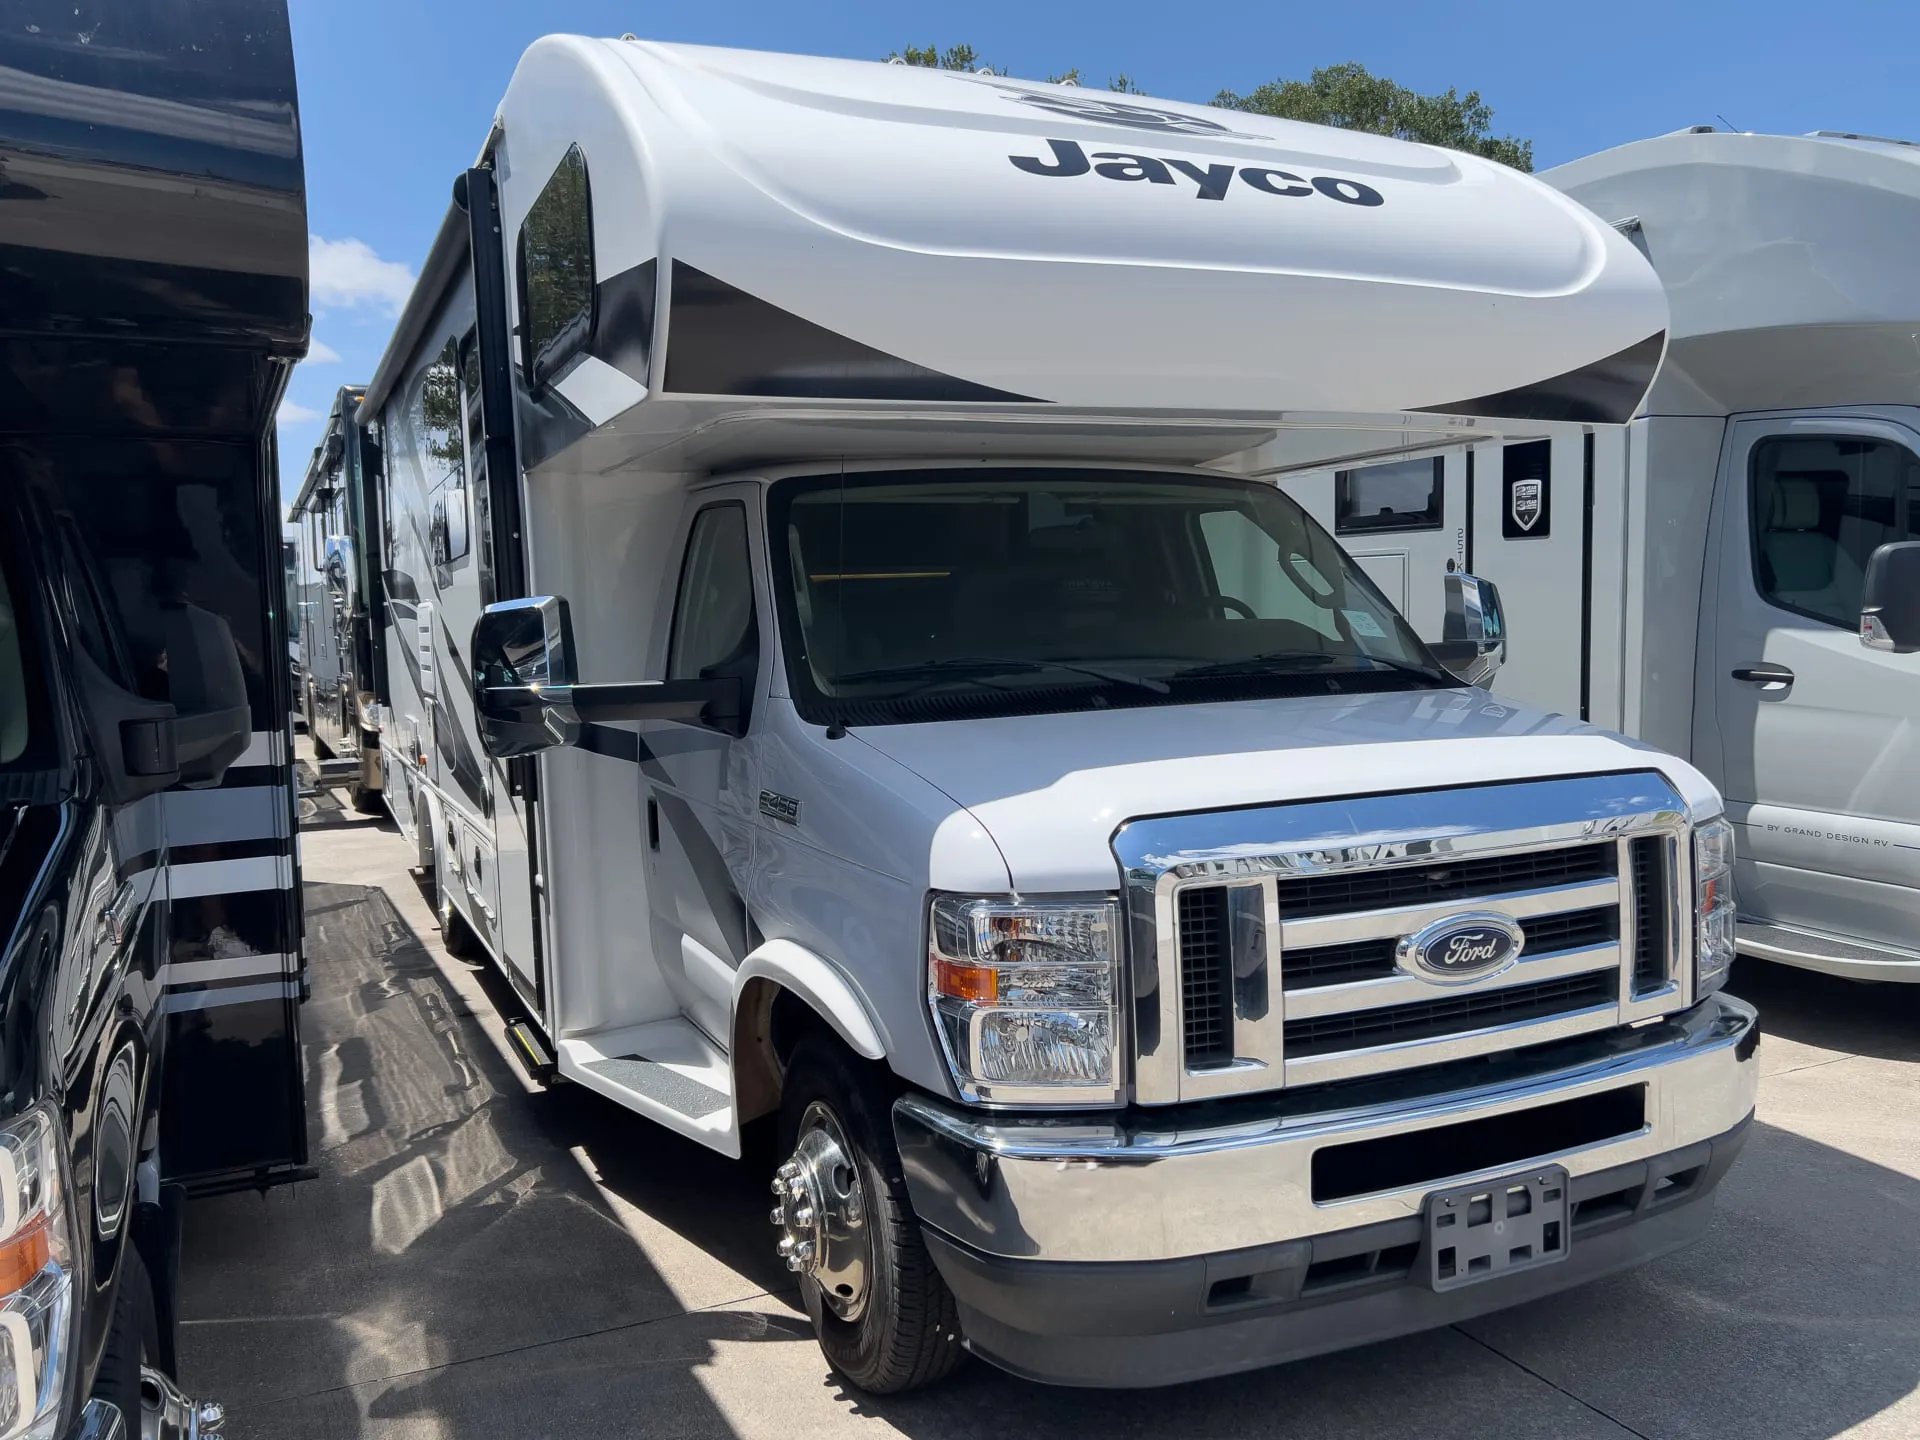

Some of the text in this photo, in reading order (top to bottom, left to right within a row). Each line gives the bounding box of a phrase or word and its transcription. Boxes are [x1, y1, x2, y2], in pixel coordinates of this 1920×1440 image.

[1008, 138, 1384, 207] Jayco
[1784, 827, 1821, 838] GRAND
[1826, 833, 1869, 845] DESIGN
[1874, 839, 1889, 848] RV
[1444, 934, 1498, 965] Ford
